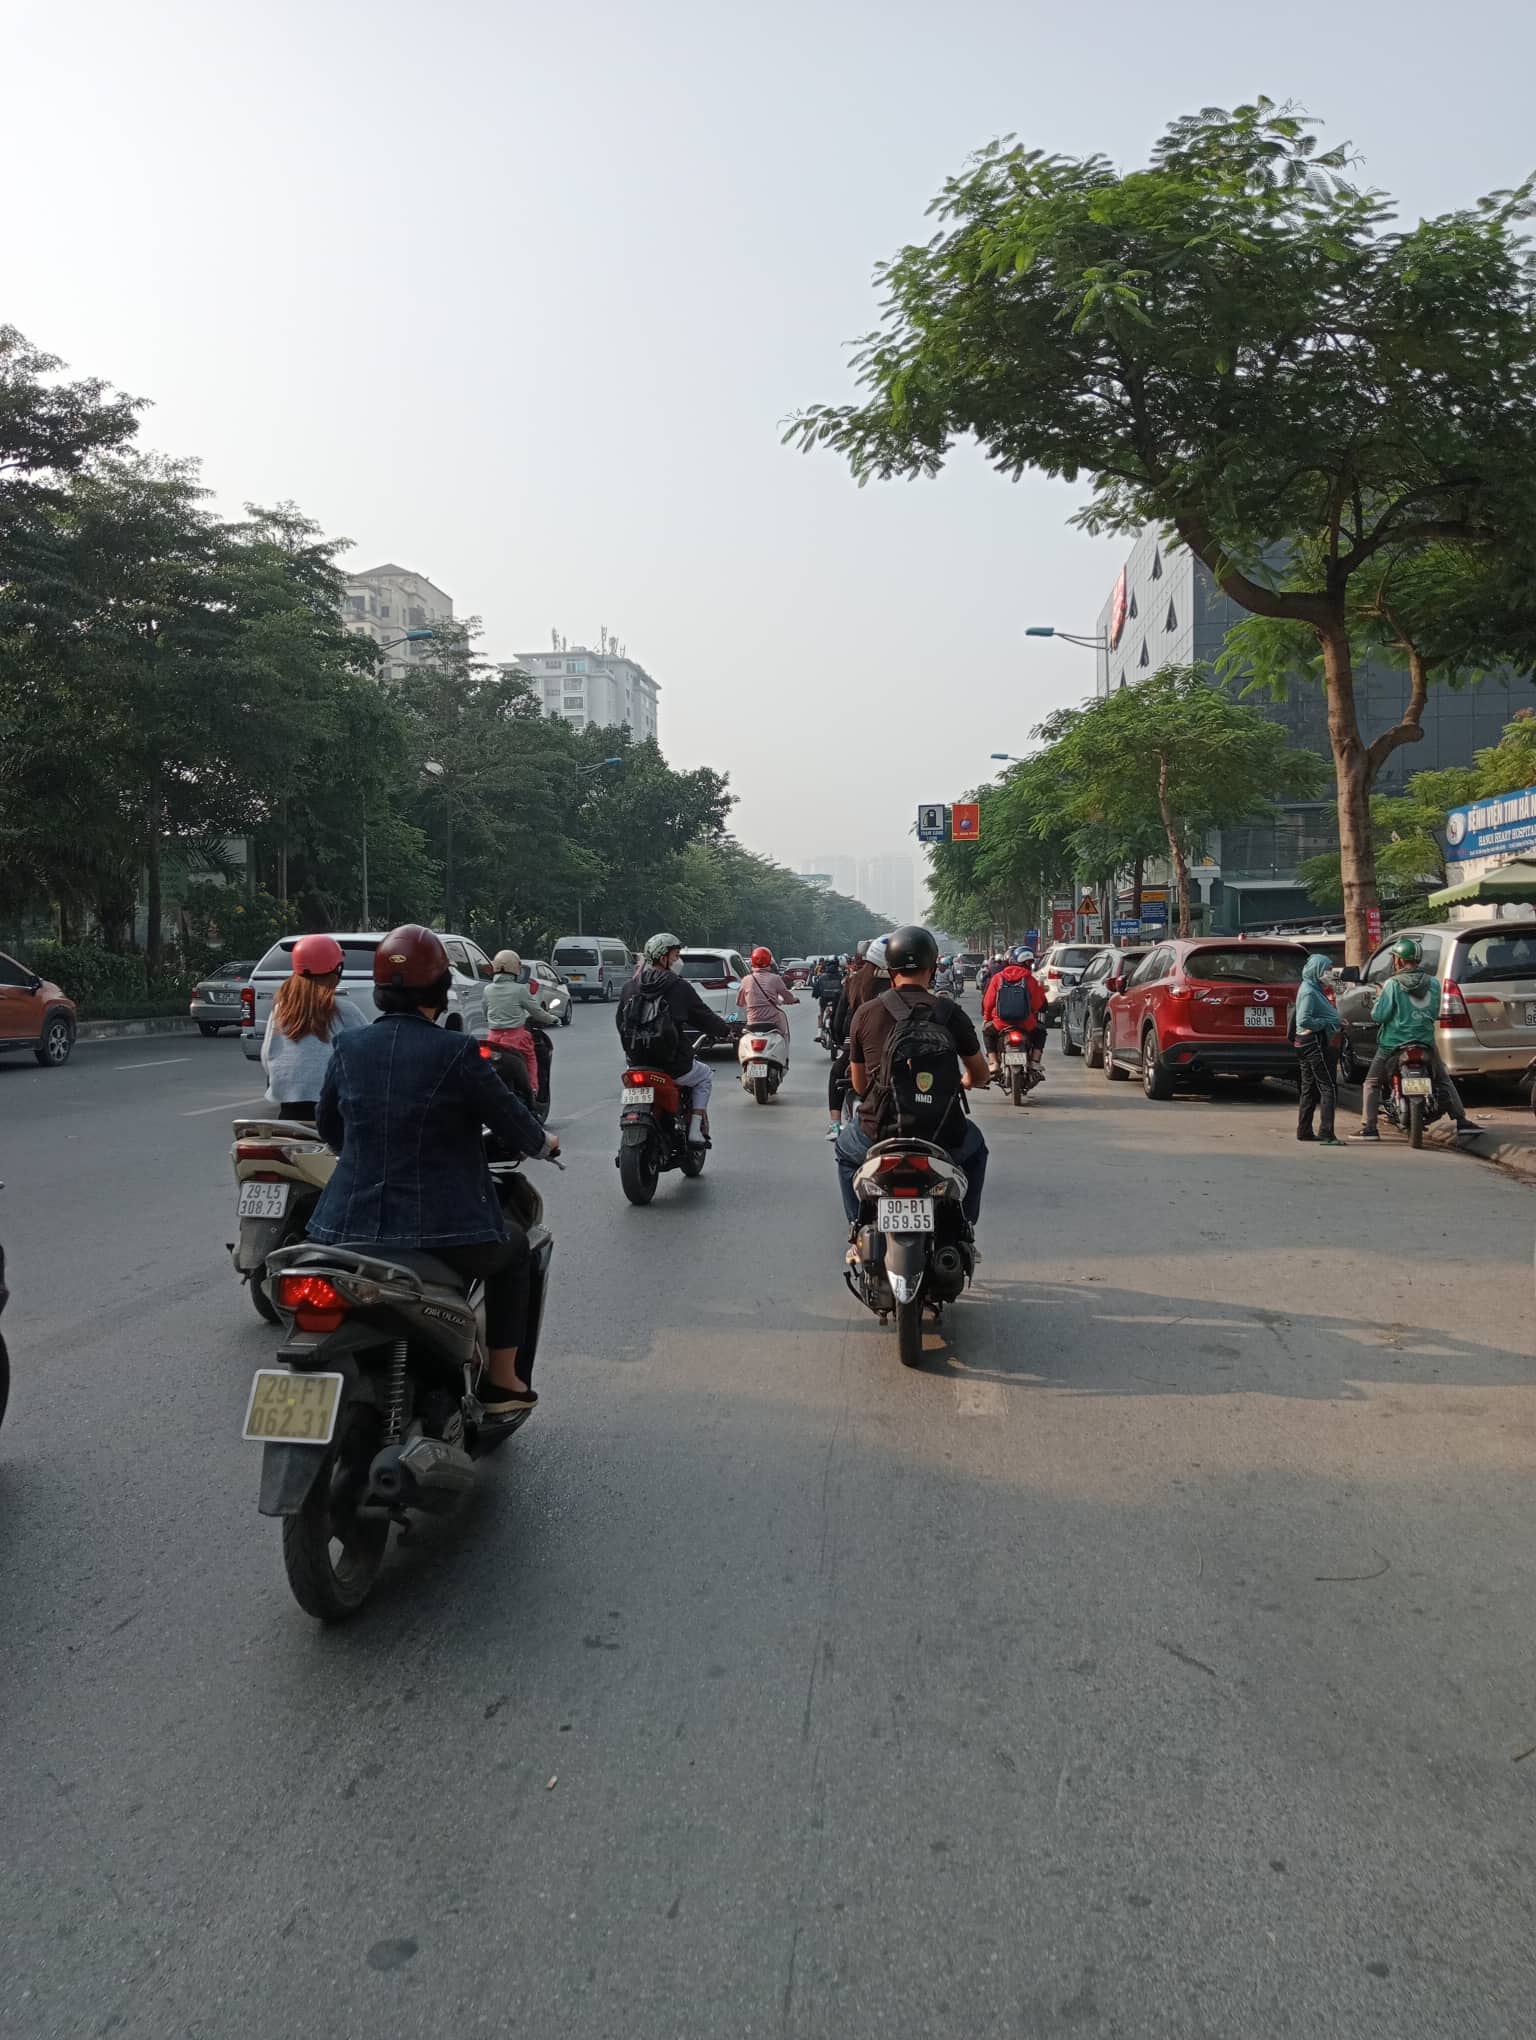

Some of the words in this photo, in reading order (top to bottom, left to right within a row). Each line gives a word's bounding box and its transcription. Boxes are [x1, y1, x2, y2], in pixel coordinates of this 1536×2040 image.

[1250, 1007, 1268, 1017] 30A
[246, 1184, 281, 1199] 29-L5
[239, 1200, 282, 1216] 308.73
[887, 1199, 925, 1214] 90-B1
[882, 1215, 931, 1230] 859.55
[262, 1376, 327, 1406] 29-F1
[250, 1407, 329, 1439] 062.31
